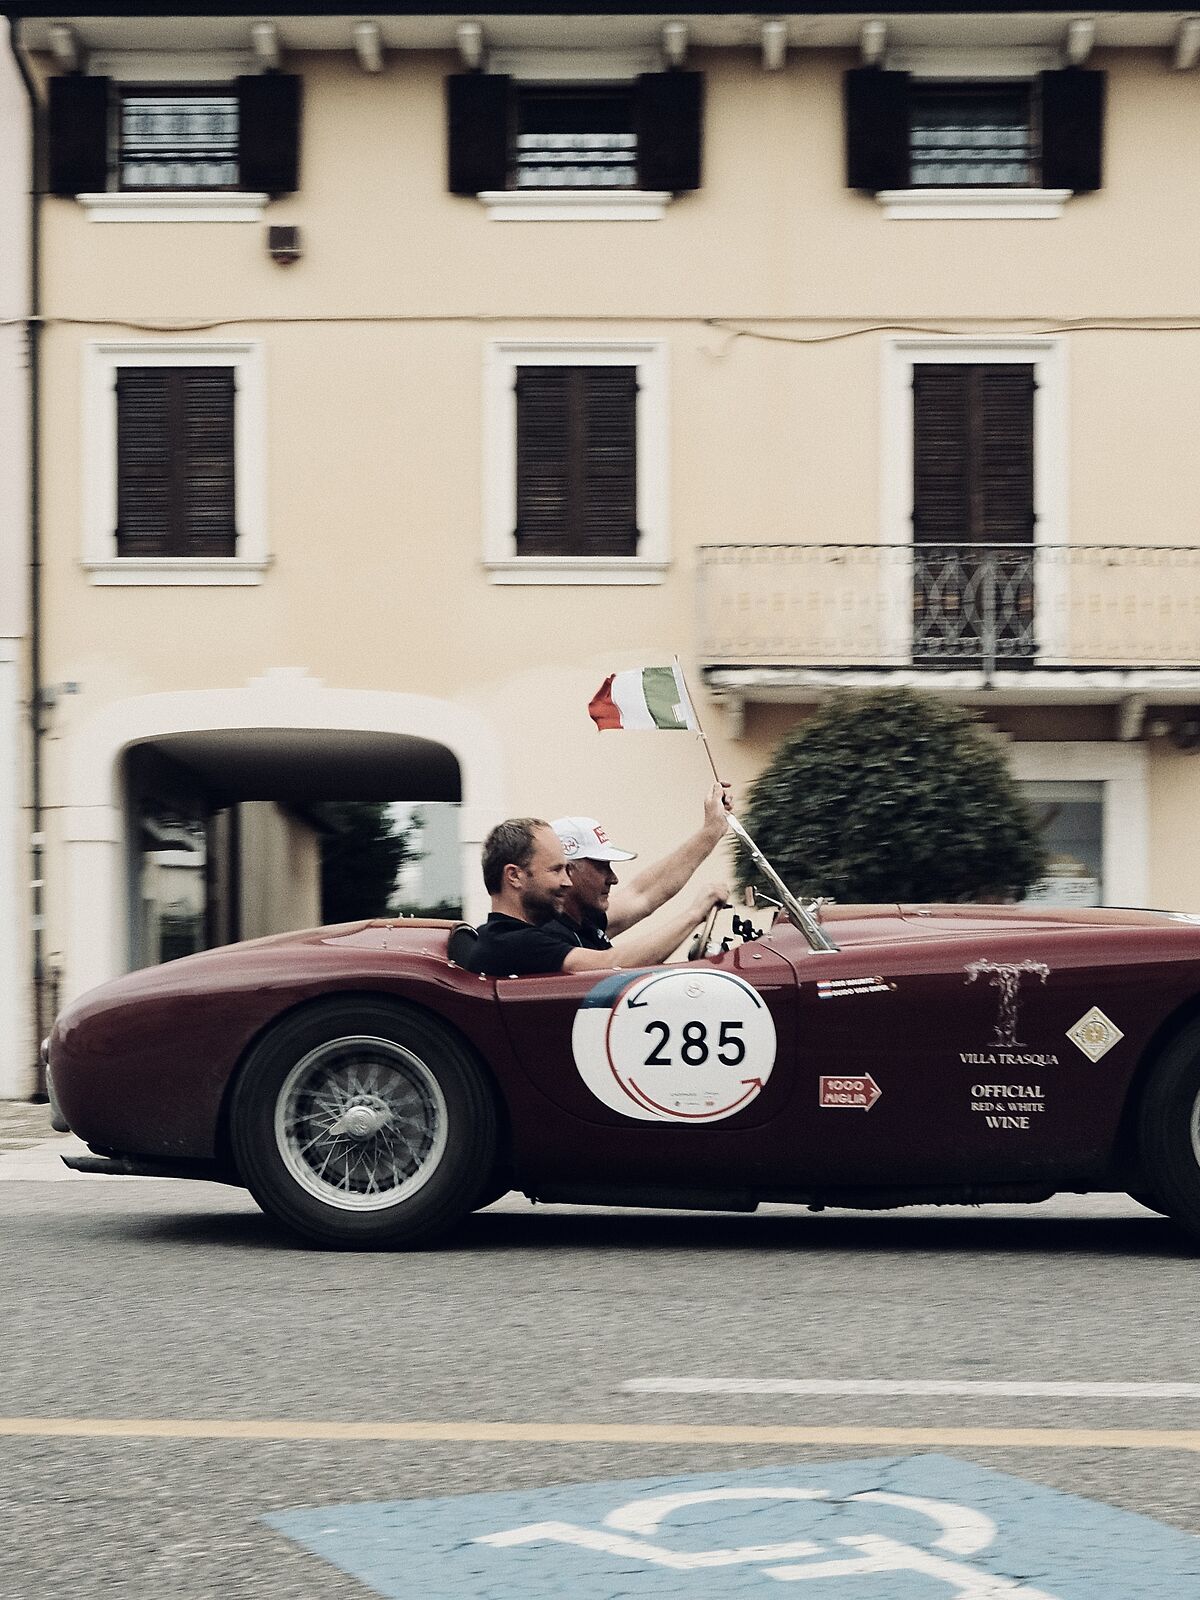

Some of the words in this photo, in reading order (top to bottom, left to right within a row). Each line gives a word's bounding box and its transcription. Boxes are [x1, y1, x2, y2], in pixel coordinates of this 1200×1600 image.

[644, 1020, 746, 1066] 285
[959, 1053, 996, 1065] VILLA
[1000, 1053, 1059, 1067] TRASQUA
[827, 1080, 865, 1091] 1000
[971, 1084, 1045, 1098] OFFICIAL
[971, 1102, 994, 1112] RED
[995, 1103, 1006, 1112] &
[1008, 1102, 1045, 1112] WHITE
[985, 1116, 1030, 1129] WINE
